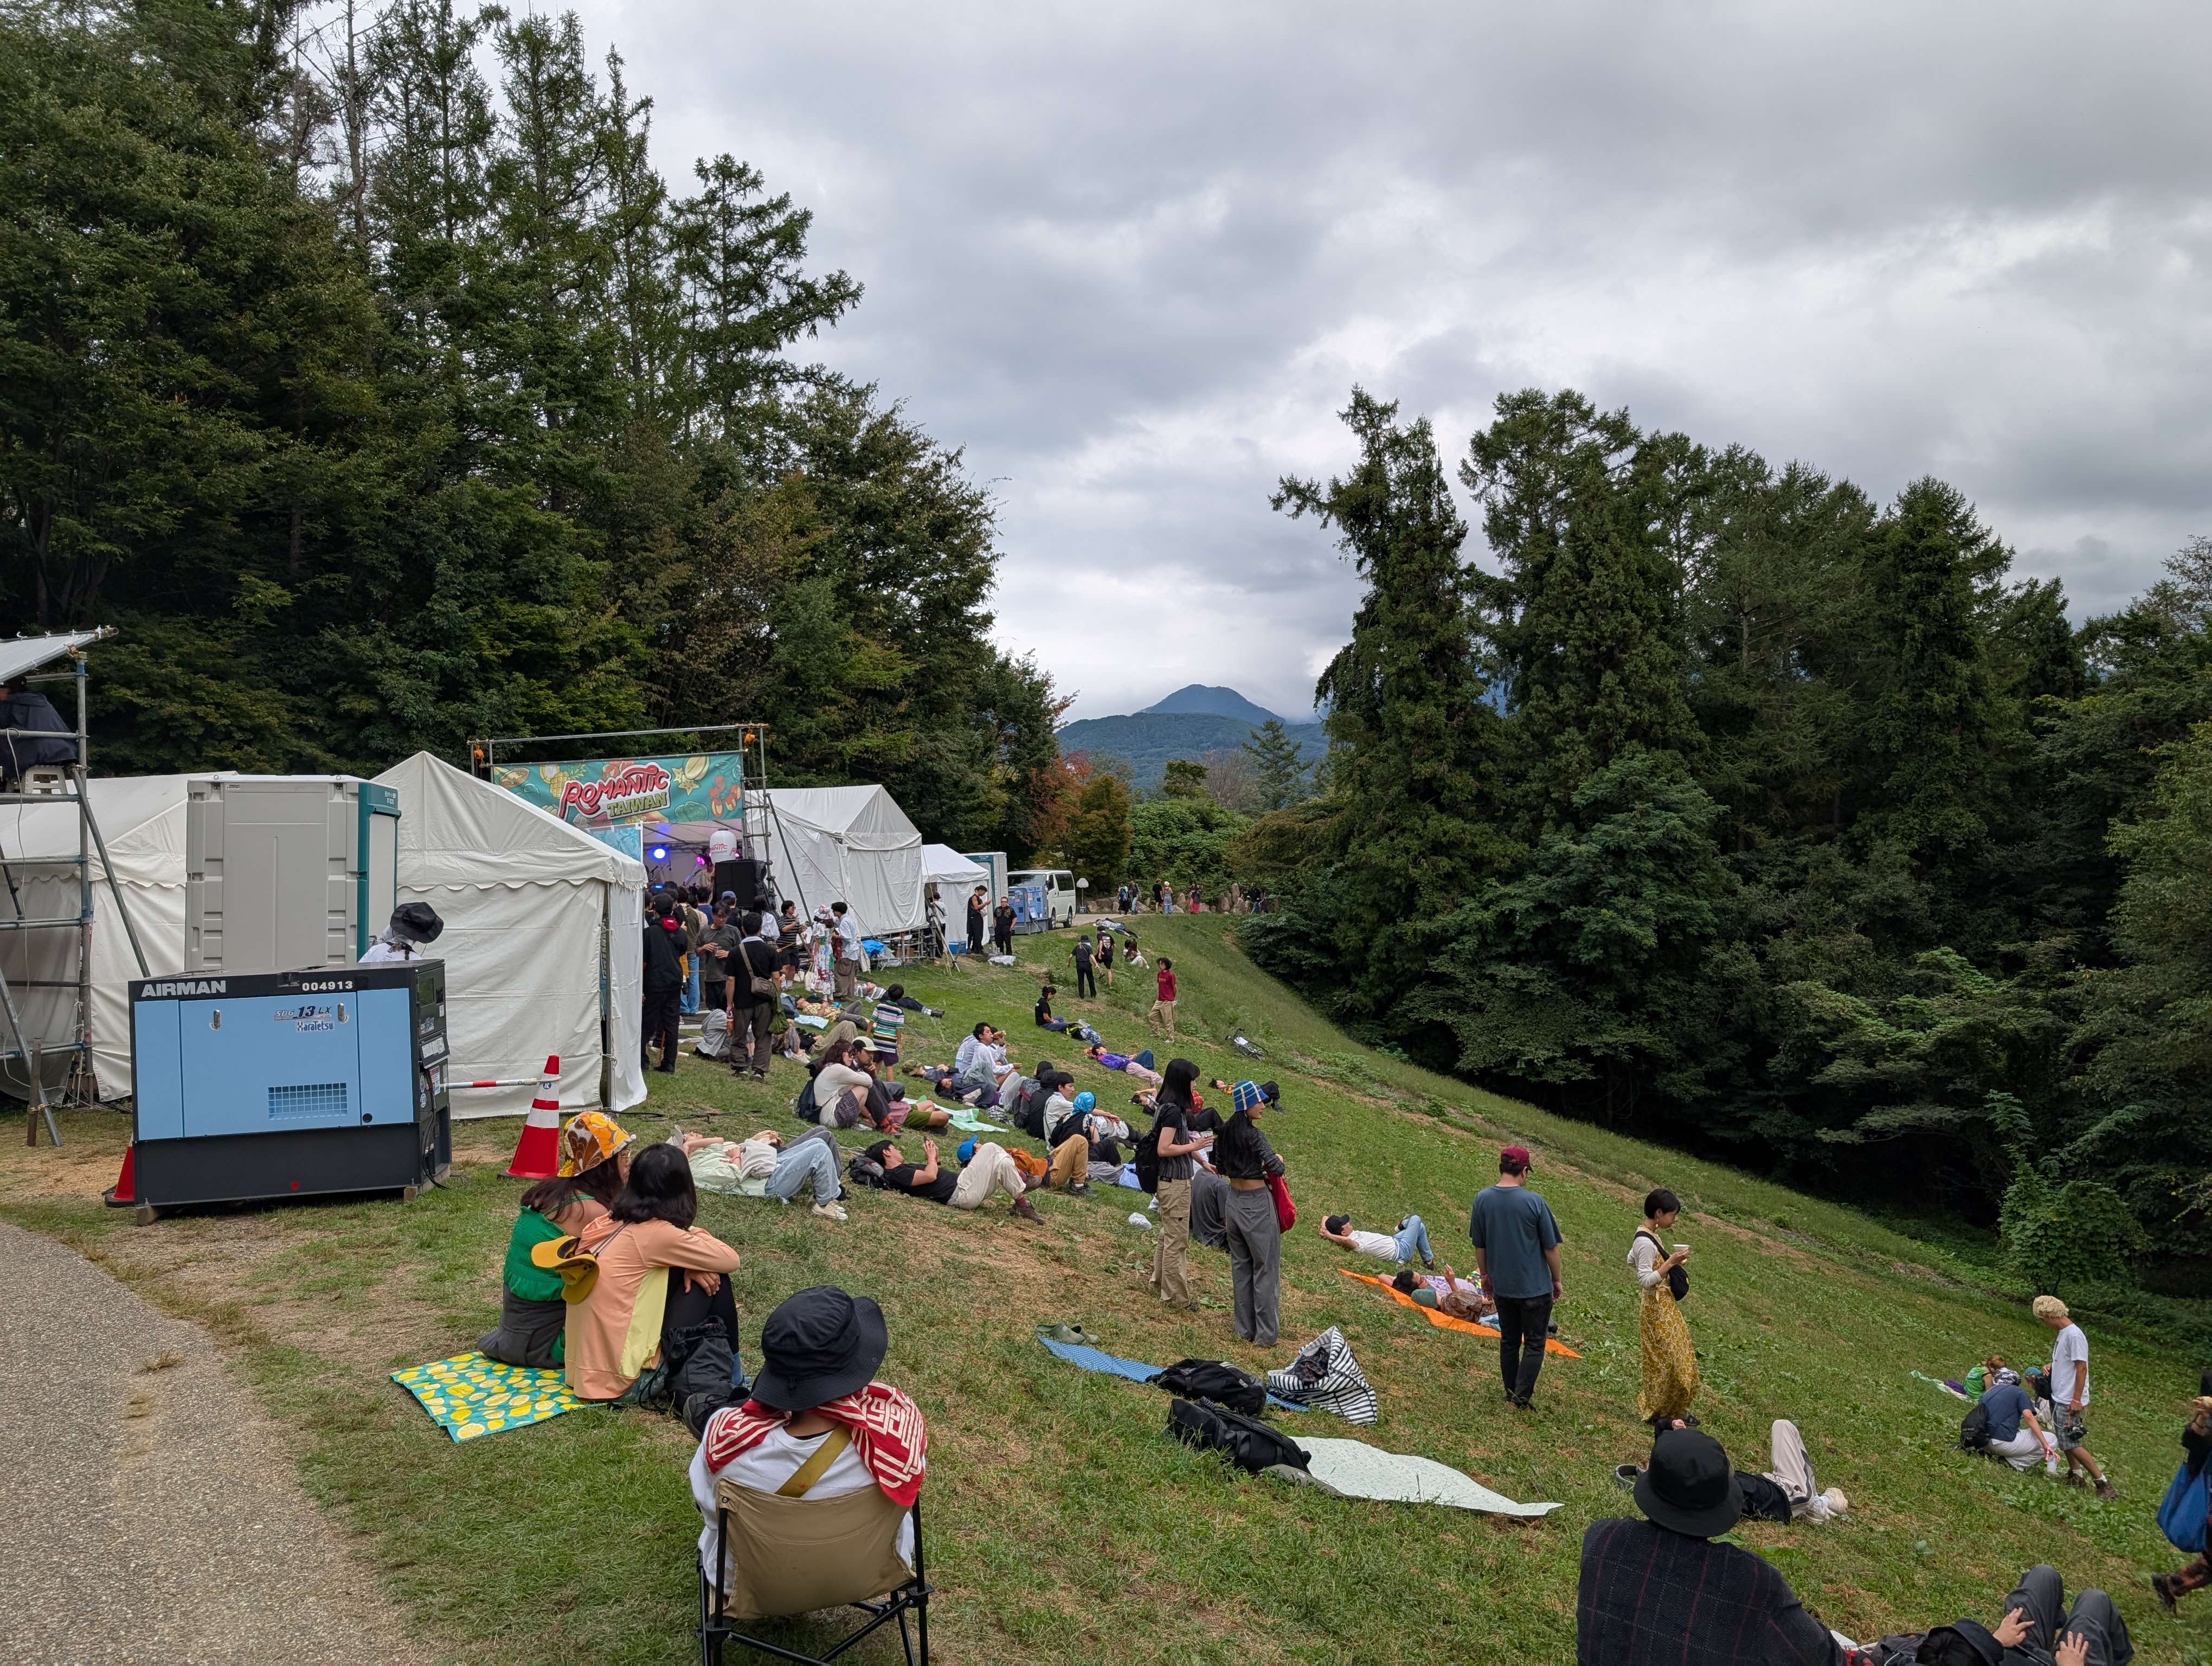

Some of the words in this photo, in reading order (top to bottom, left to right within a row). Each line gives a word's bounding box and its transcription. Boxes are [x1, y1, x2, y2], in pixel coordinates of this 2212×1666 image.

[558, 765, 670, 819] ROMANTIC
[607, 792, 667, 817] TAIWAN
[140, 980, 226, 997] AIRMAN
[302, 981, 353, 991] 004913
[275, 1009, 295, 1017] SDG
[298, 1005, 316, 1017] 13
[318, 1006, 332, 1014] LX
[297, 1020, 334, 1031] HaraTetsu
